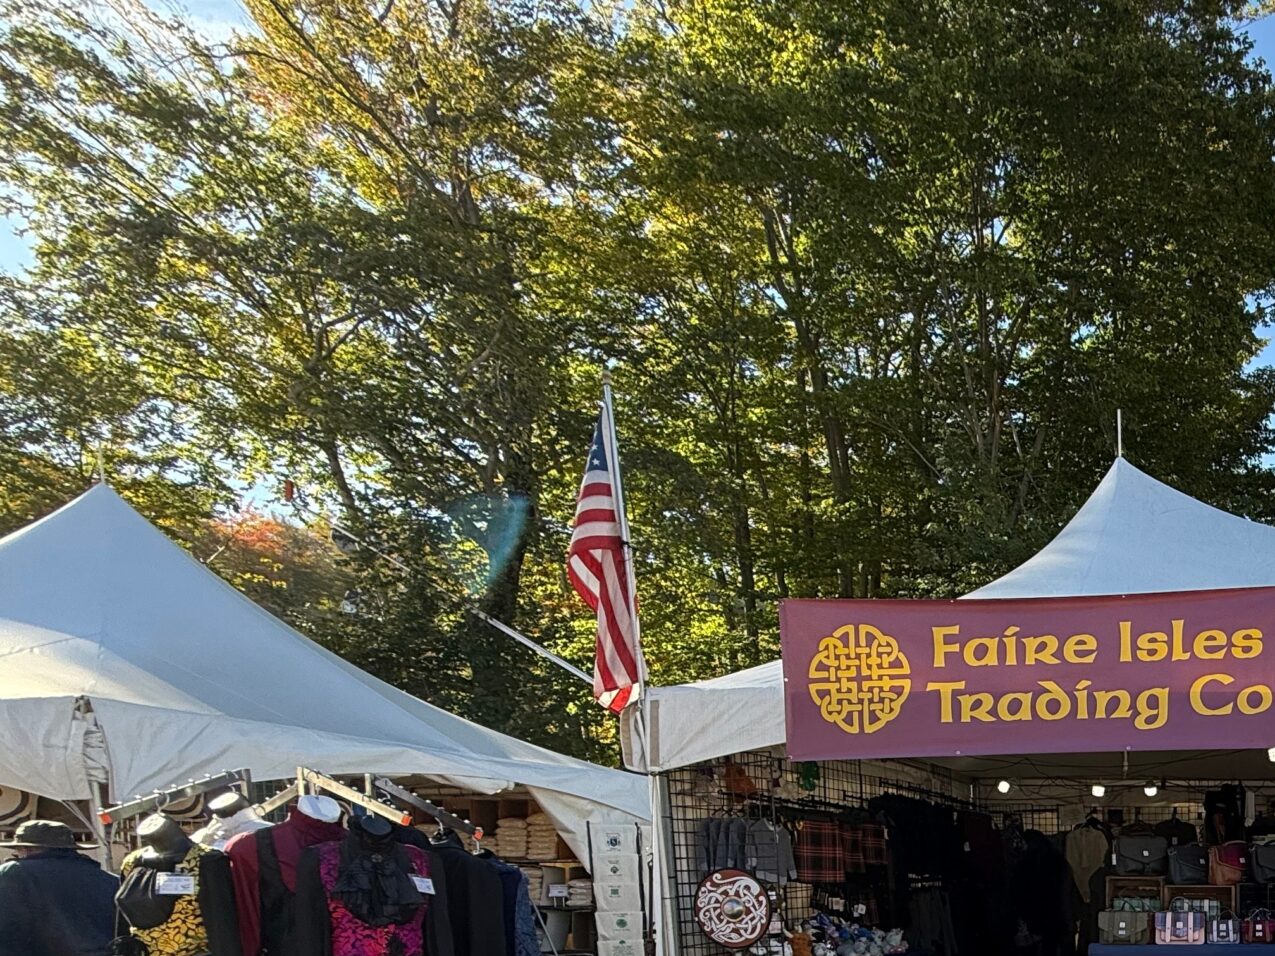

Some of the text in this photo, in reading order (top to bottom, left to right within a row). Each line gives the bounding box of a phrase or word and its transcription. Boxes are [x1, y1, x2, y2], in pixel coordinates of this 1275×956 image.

[931, 620, 1264, 668] Faire Isles
[926, 673, 1273, 730] Trading Co
